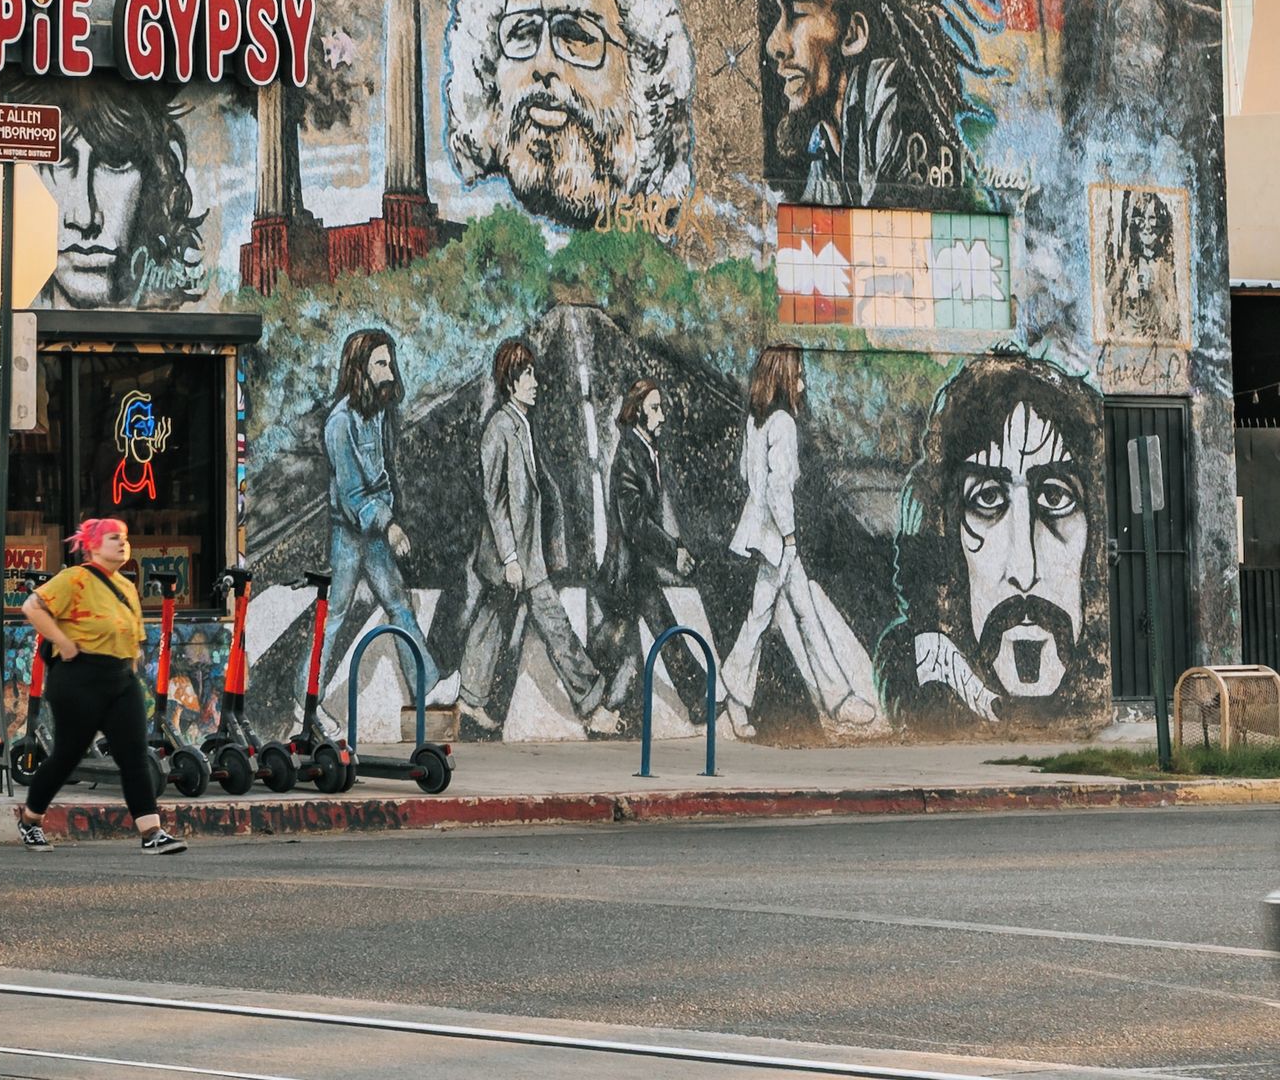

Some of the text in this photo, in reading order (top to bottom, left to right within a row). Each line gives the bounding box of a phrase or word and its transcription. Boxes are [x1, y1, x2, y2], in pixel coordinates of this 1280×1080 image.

[7, 110, 41, 124] ALLEN
[3, 148, 27, 157] HISTORIC
[28, 150, 52, 158] DISTRICT
[4, 569, 26, 579] ERE
